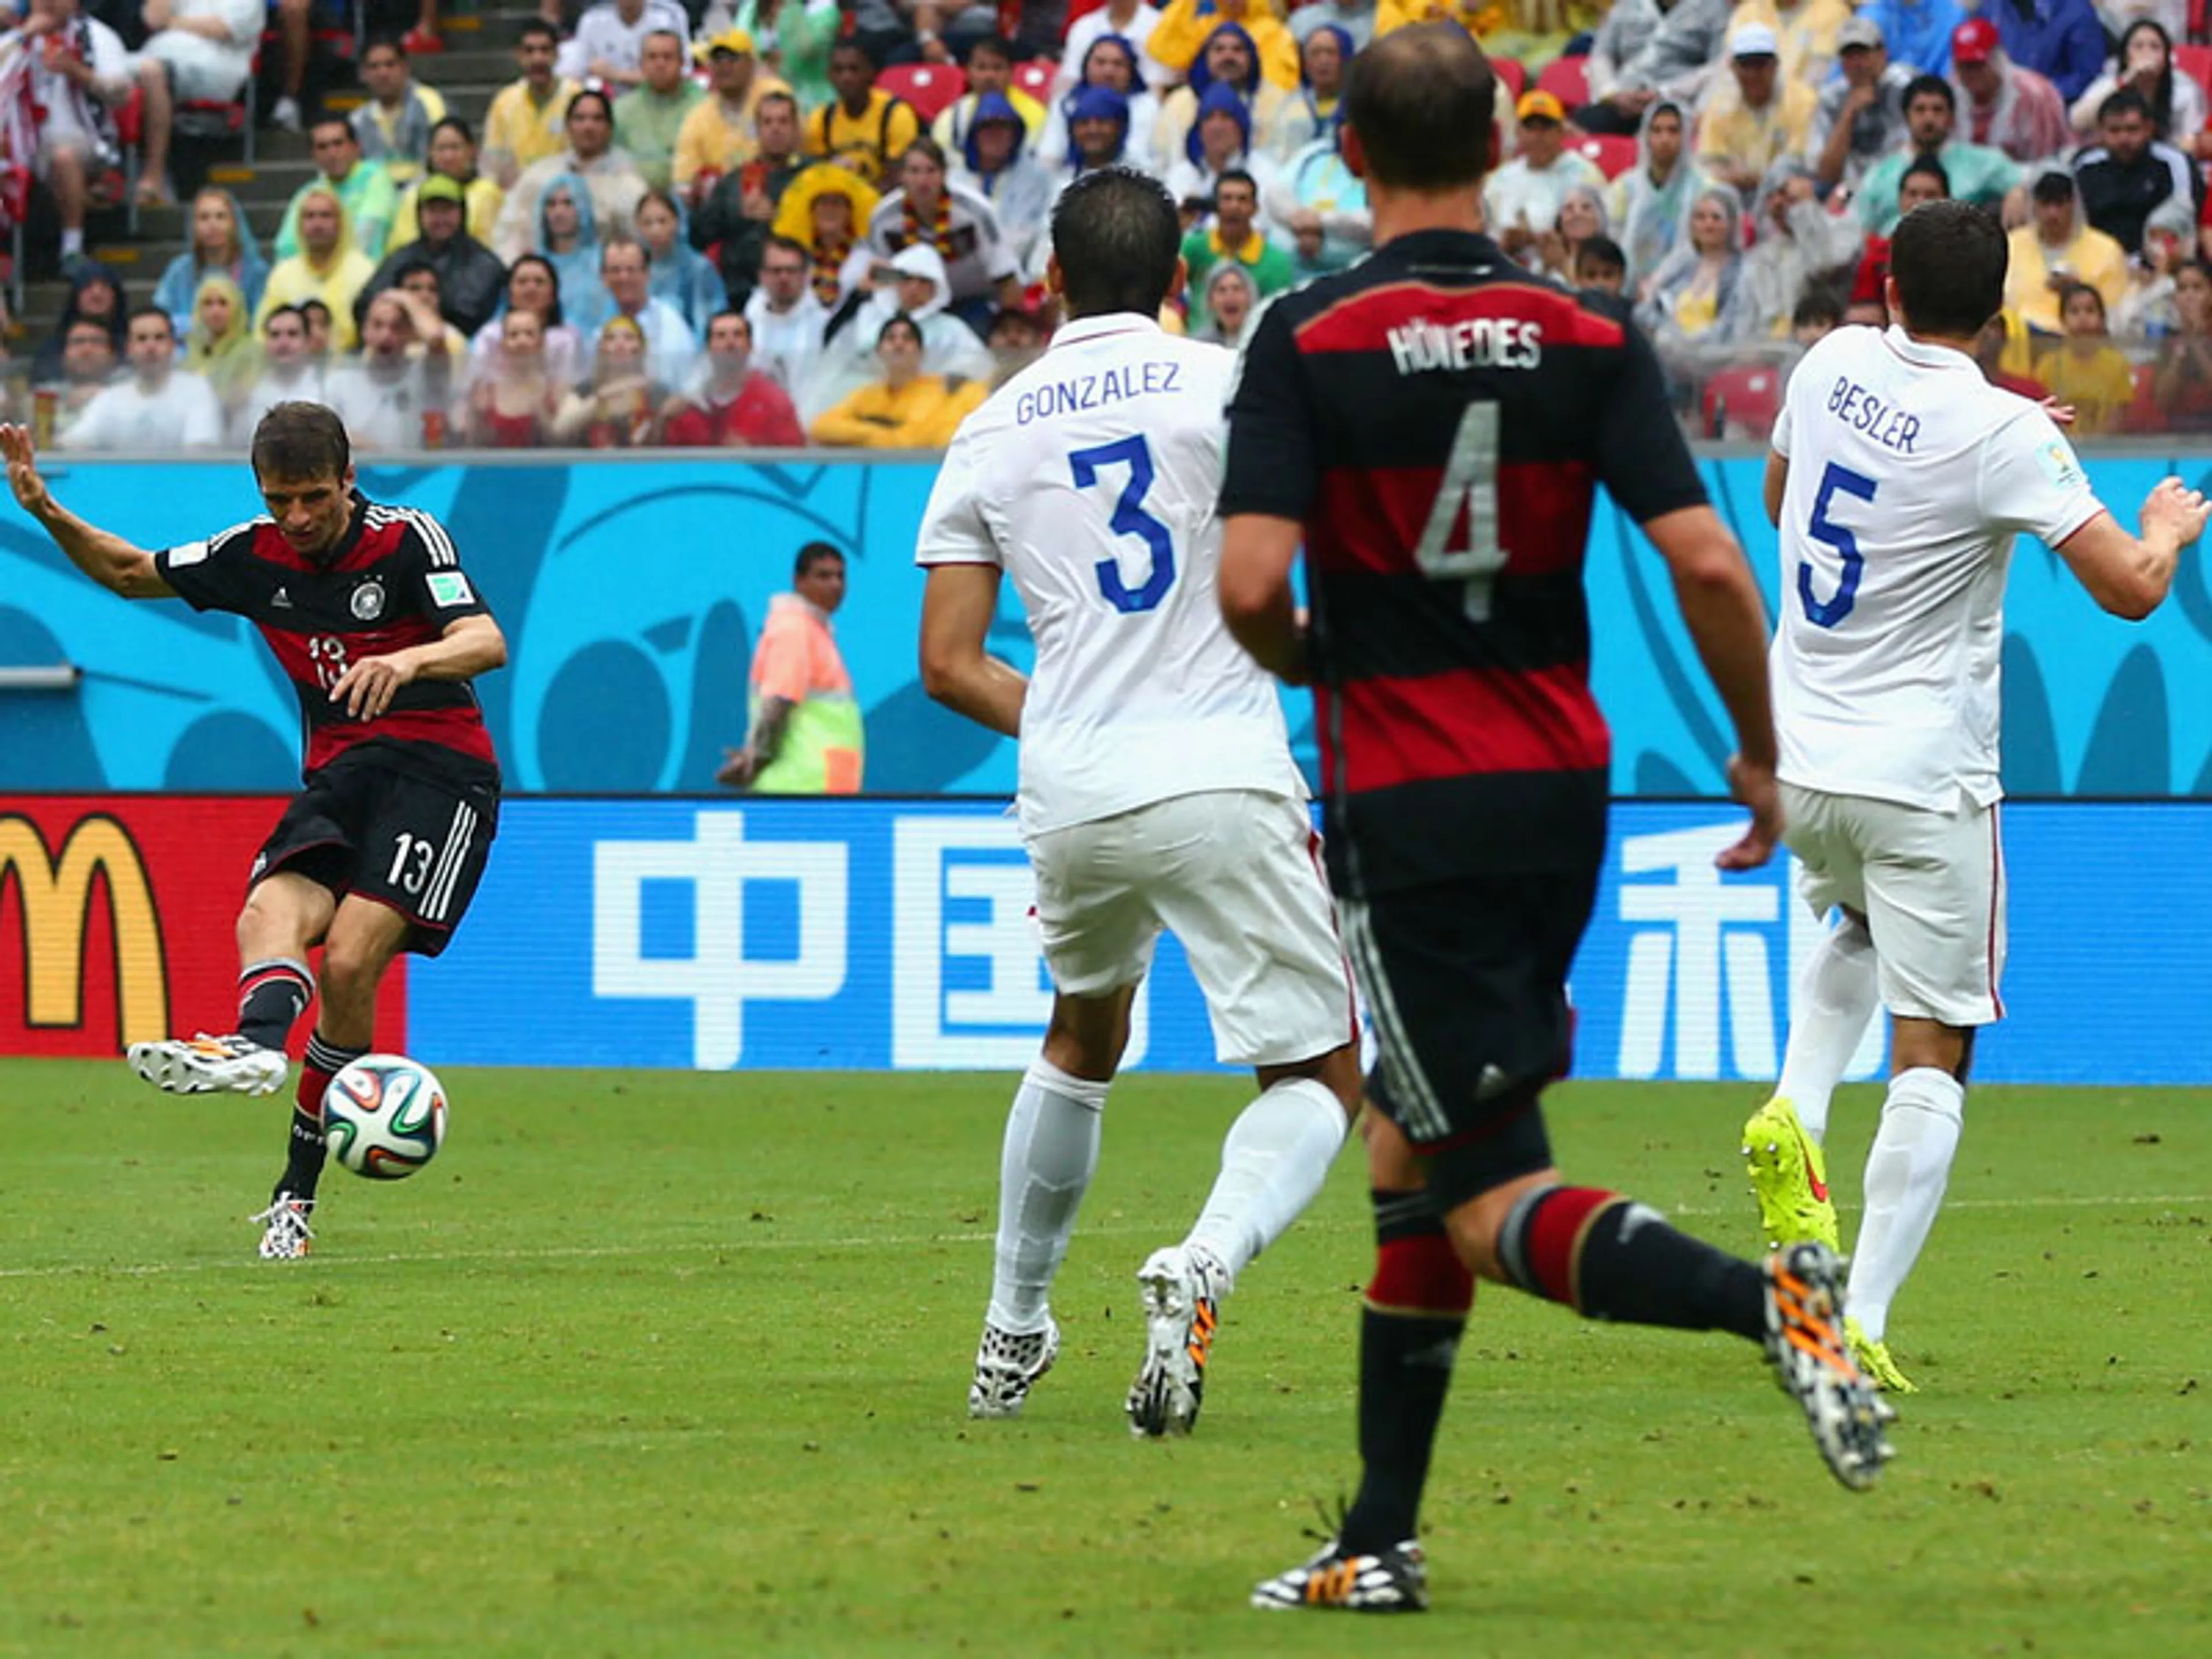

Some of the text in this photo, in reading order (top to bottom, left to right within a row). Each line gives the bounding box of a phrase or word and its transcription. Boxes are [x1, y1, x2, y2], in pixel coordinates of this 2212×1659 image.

[1017, 362, 1182, 426] GONZALEZ
[1828, 376, 1921, 453] BESLER
[1068, 433, 1176, 613] 3
[1415, 400, 1510, 621] 4
[1798, 461, 1878, 628] 5
[309, 636, 348, 690] 13
[387, 832, 434, 894] 13
